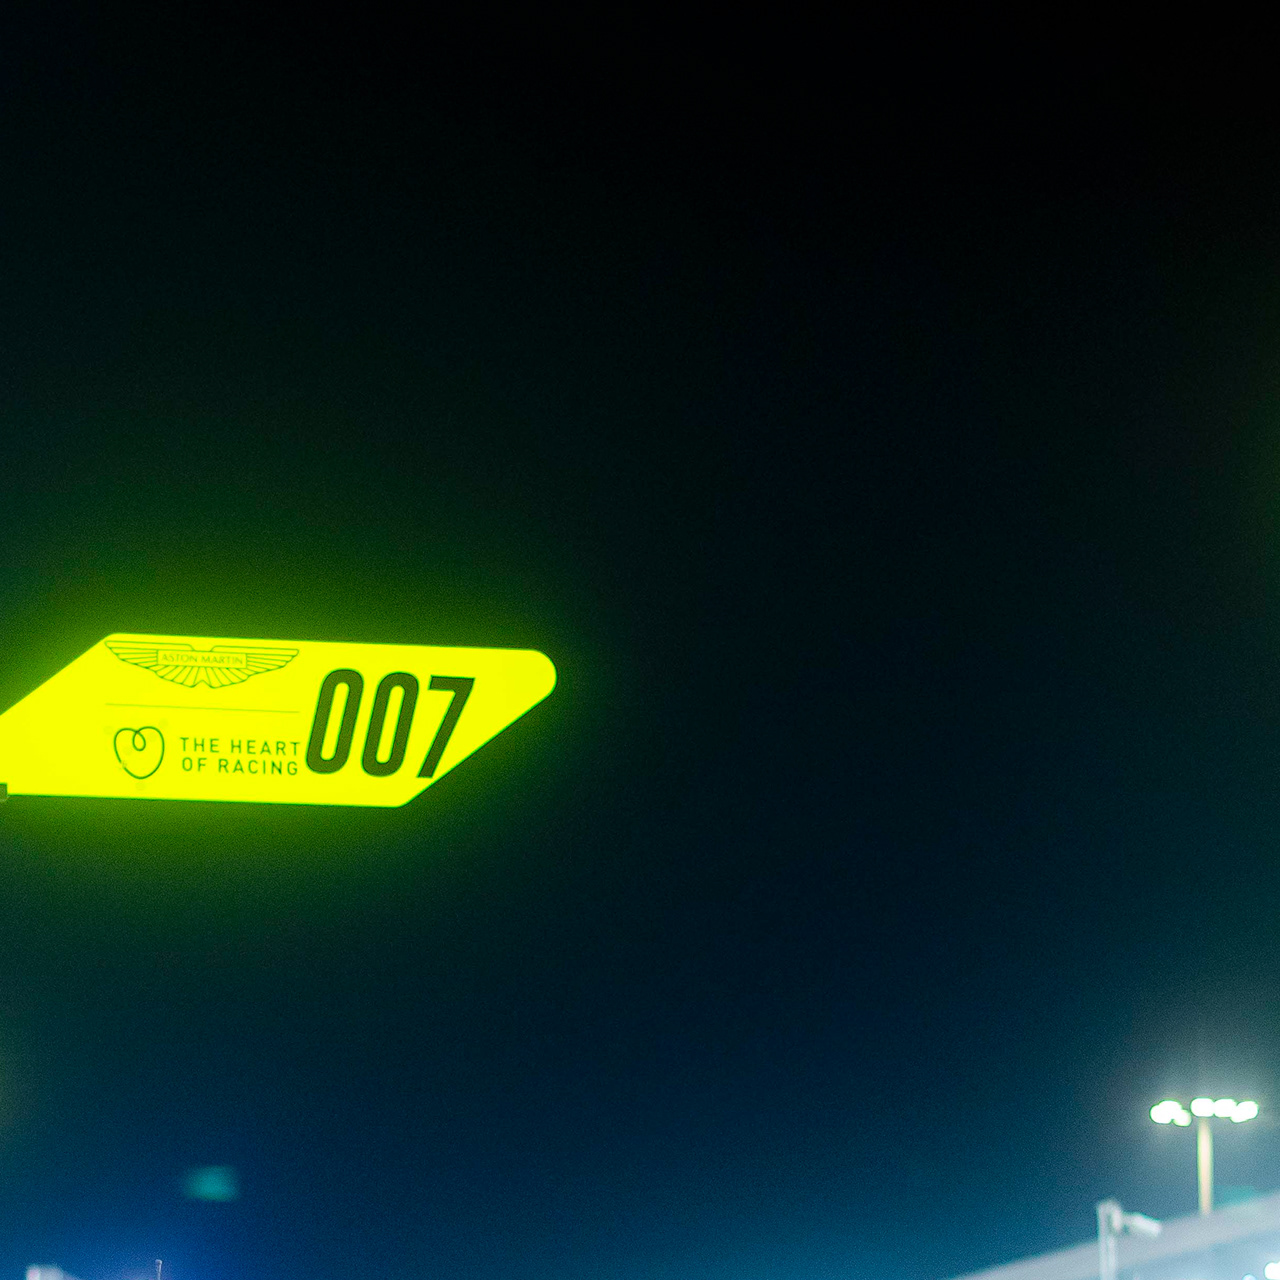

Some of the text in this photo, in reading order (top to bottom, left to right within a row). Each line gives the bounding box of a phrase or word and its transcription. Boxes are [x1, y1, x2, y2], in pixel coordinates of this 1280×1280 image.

[161, 653, 243, 665] ASTON MARTIN
[305, 668, 476, 778] 007
[180, 737, 301, 756] THE HEART
[182, 757, 298, 776] OF RACING
